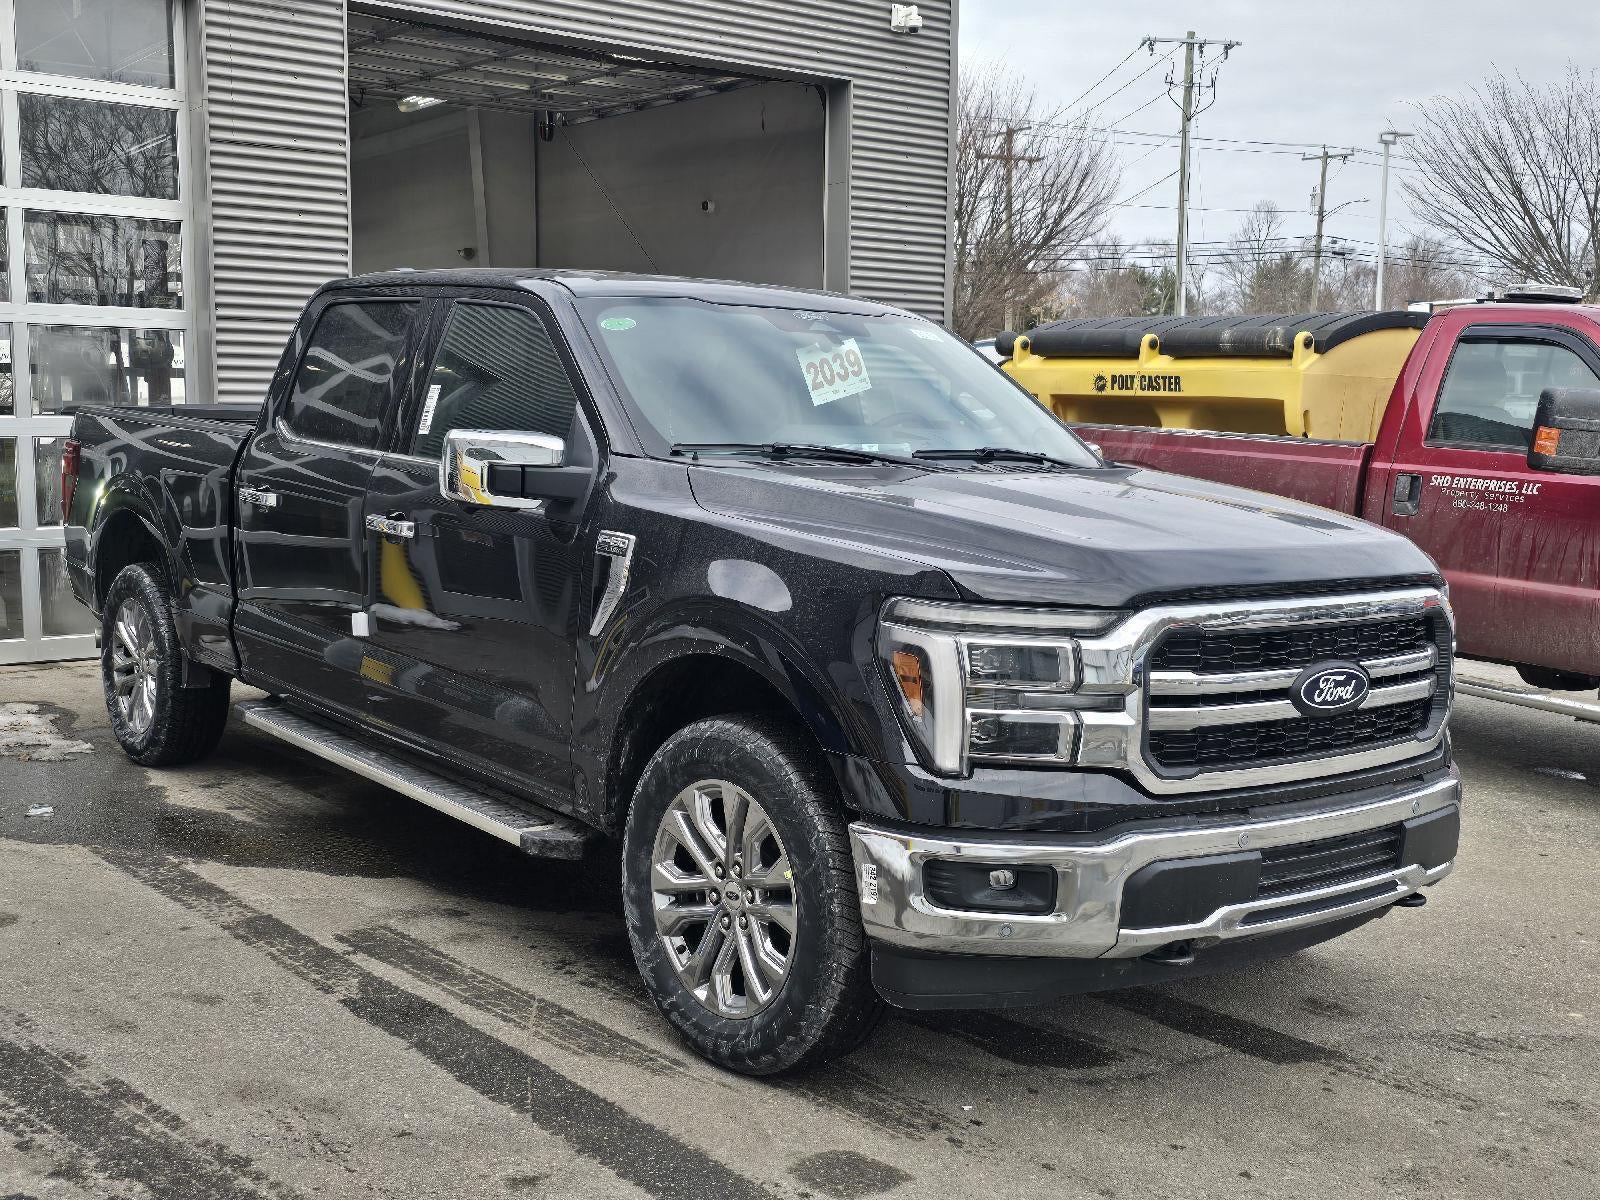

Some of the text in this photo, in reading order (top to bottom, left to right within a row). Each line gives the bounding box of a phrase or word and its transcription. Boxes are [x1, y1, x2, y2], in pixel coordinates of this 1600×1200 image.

[805, 348, 862, 391] 2039
[1110, 374, 1183, 392] POLY CASTER
[1441, 487, 1525, 503] Property Services
[1452, 476, 1519, 494] ENTERPRISES,
[1521, 482, 1541, 495] LLC
[1314, 675, 1356, 702] Ford
